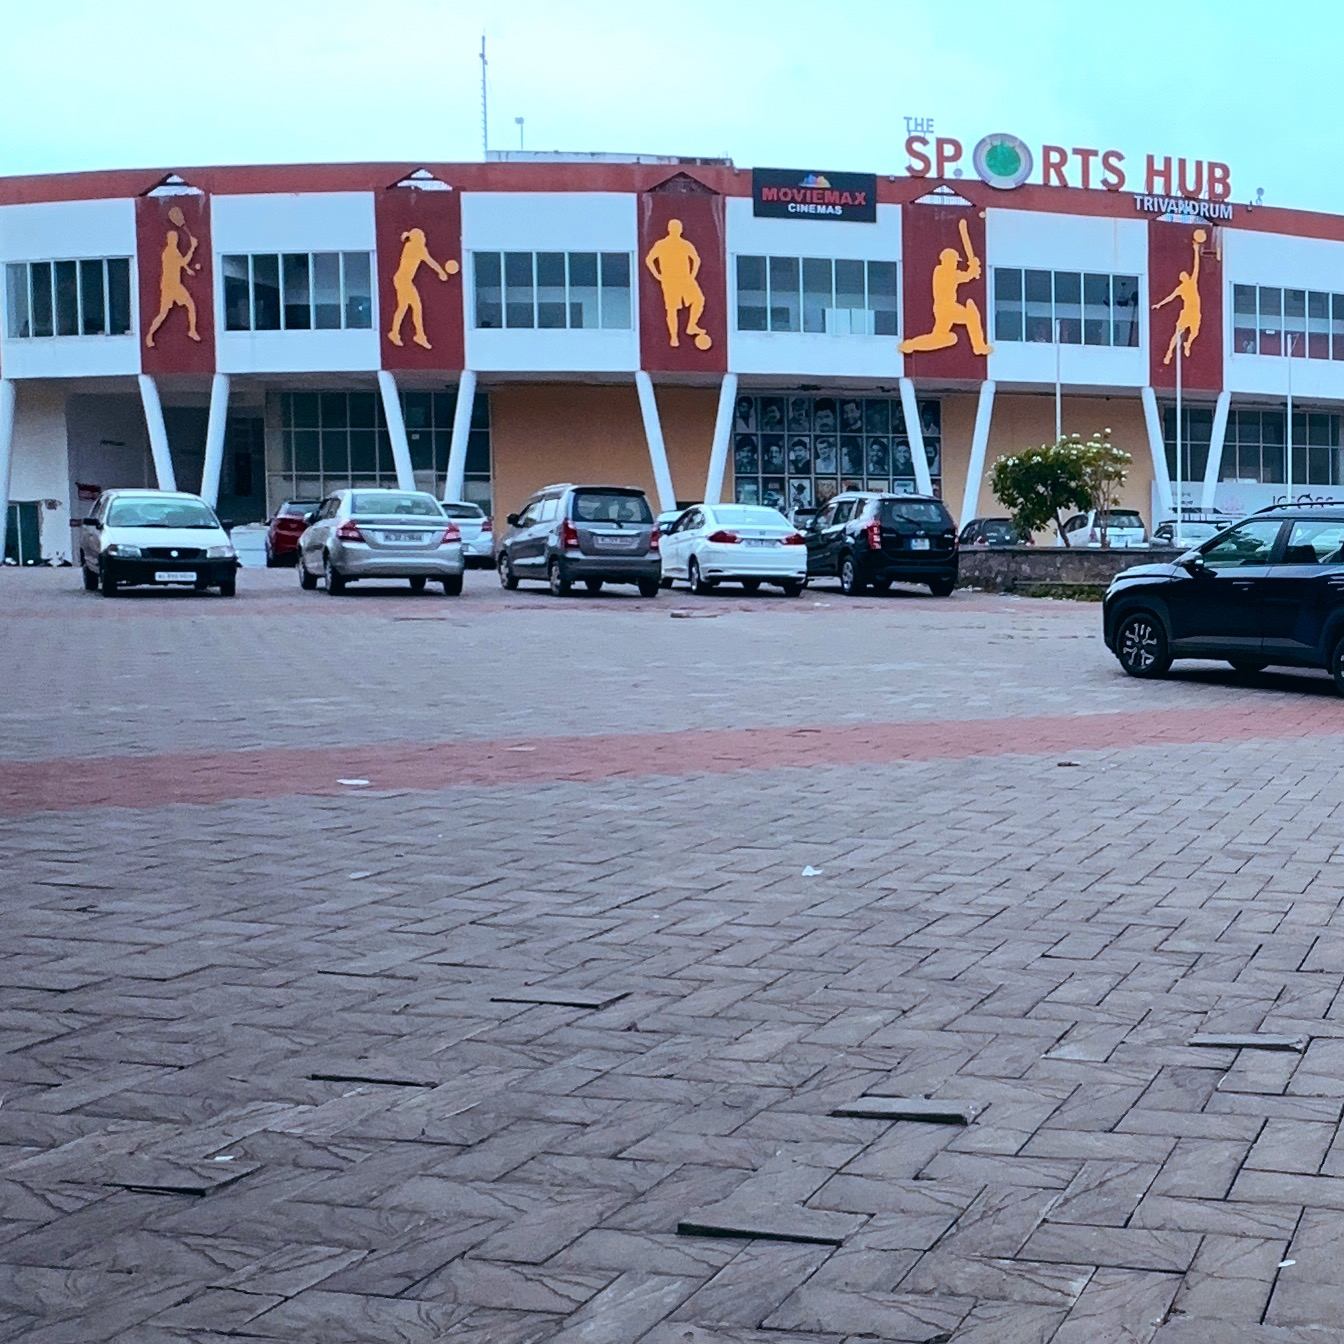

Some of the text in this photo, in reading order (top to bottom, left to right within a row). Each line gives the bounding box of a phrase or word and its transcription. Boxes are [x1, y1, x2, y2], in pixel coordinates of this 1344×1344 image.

[903, 116, 934, 134] THE
[1146, 154, 1232, 202] HUB
[762, 187, 866, 205] MOVIEMAX
[787, 202, 843, 216] CINEMAS
[1134, 195, 1233, 220] TRIVANDRUM
